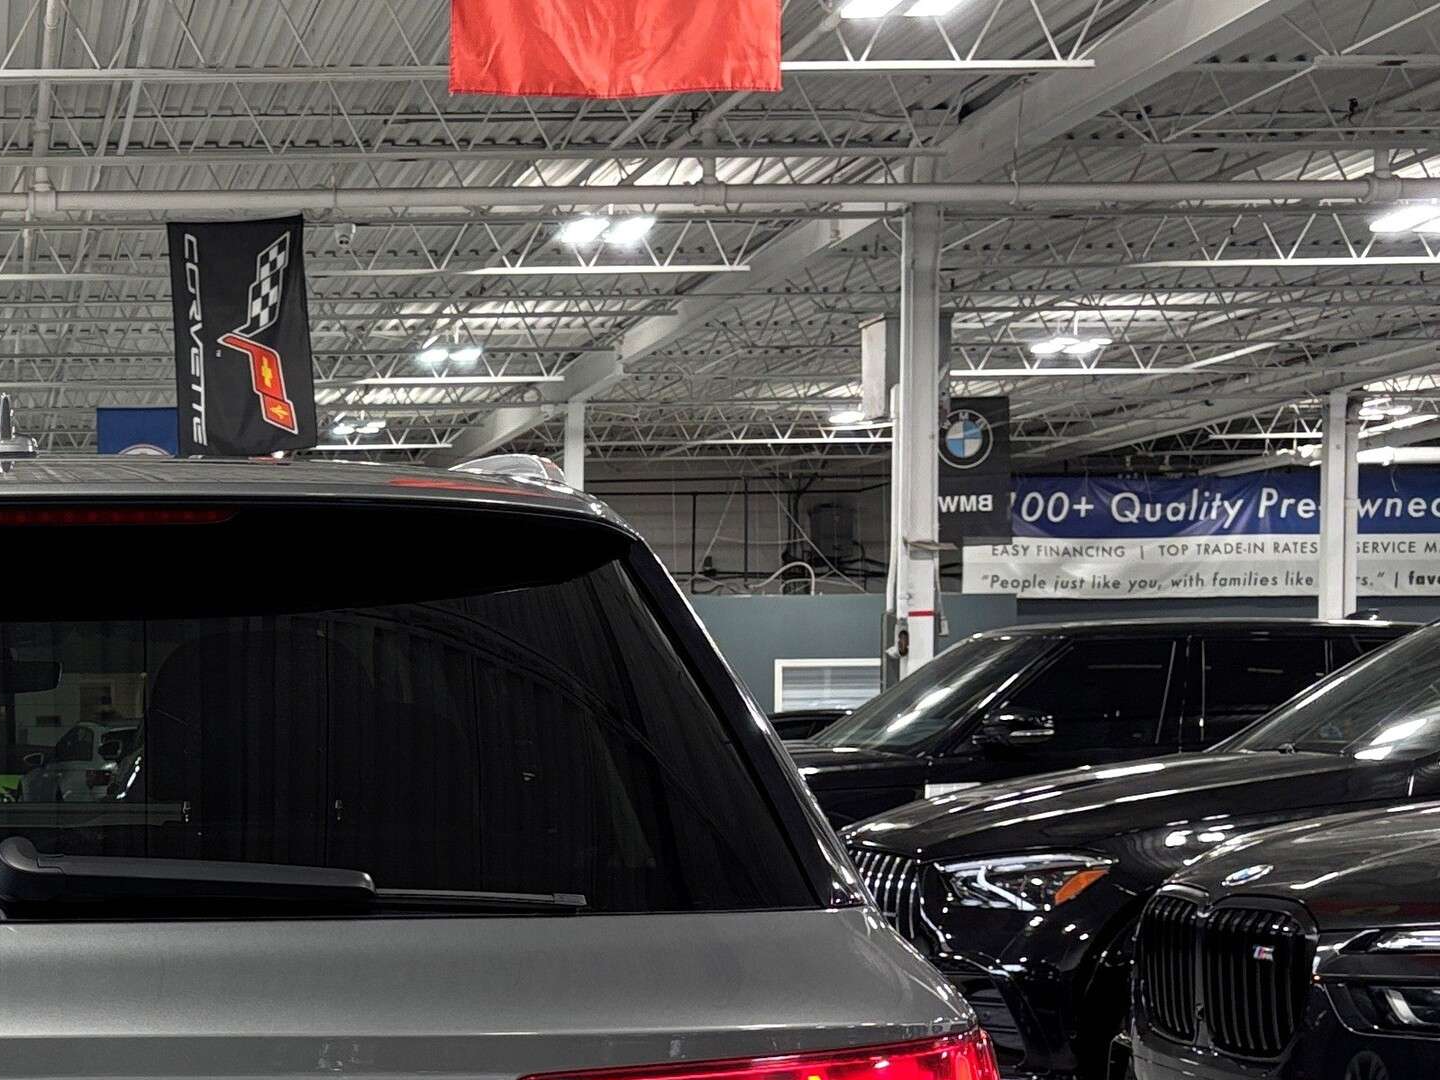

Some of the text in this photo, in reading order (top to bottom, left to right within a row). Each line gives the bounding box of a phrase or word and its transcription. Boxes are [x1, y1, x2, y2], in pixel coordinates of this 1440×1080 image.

[184, 233, 208, 446] CORVETTE
[1111, 488, 1244, 529] Quality
[992, 544, 1030, 558] EASY
[1036, 544, 1125, 559] FINANCING
[1158, 544, 1189, 557] TOP
[1196, 543, 1265, 556] TRADE-IN
[1273, 541, 1318, 555] RATES
[1053, 573, 1085, 591] just
[1091, 572, 1122, 588] like
[1128, 577, 1161, 593] you,
[1171, 573, 1205, 586] with
[1211, 571, 1279, 588] families
[1284, 571, 1315, 586] like
